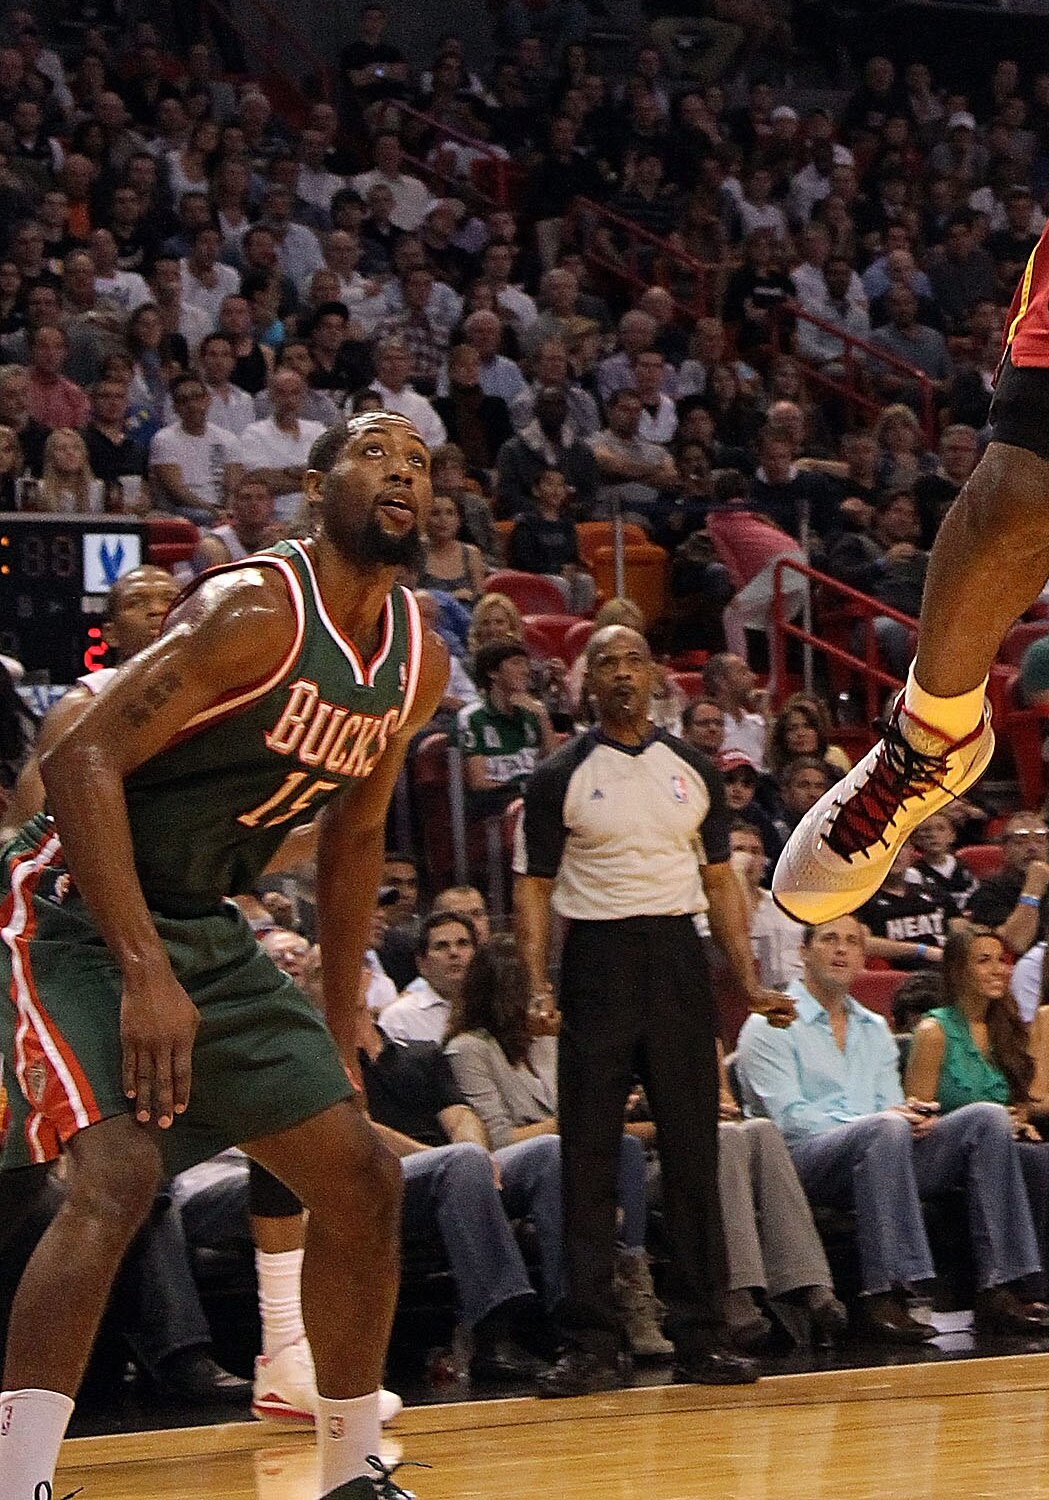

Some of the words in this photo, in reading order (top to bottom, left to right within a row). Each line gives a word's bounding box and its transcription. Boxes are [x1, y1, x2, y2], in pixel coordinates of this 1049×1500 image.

[265, 678, 400, 777] BUCKS
[237, 771, 339, 828] 15
[886, 906, 945, 941] HEAT
